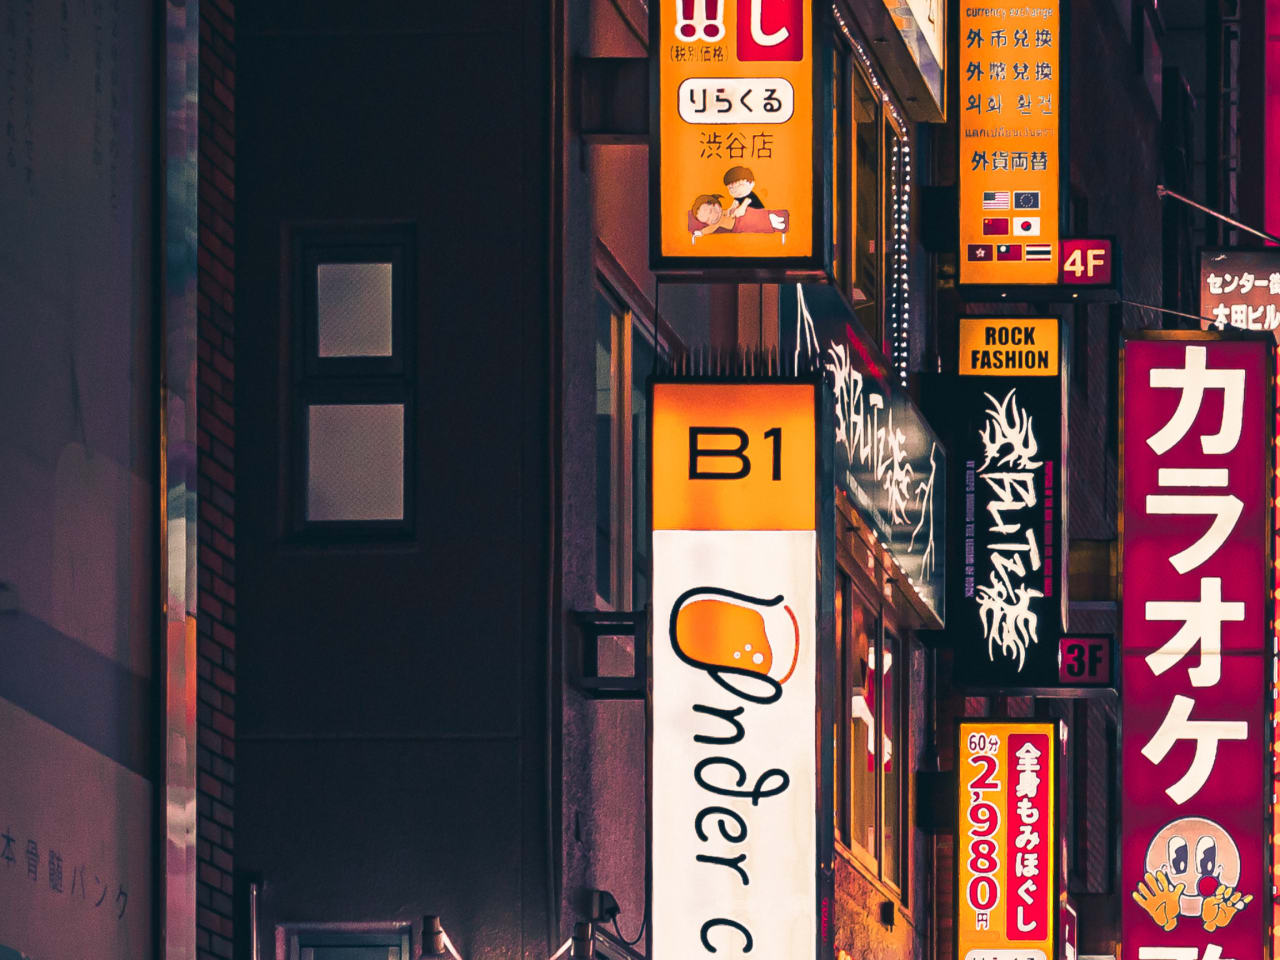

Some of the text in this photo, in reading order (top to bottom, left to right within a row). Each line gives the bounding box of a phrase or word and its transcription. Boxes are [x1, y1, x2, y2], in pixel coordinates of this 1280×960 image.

[689, 85, 784, 115] りらくる
[699, 131, 775, 160] 渋谷店
[971, 149, 1049, 172] 外貨両替
[1063, 248, 1105, 277] 4F
[985, 326, 1036, 346] ROCK
[970, 349, 1050, 370] FASHION
[688, 426, 783, 481] B1
[1140, 345, 1247, 806] カラオケ
[1066, 643, 1104, 676] 3F
[968, 733, 1001, 753] 60分
[967, 754, 1002, 931] 2,980円
[1015, 741, 1043, 933] 全身もみほぐし
